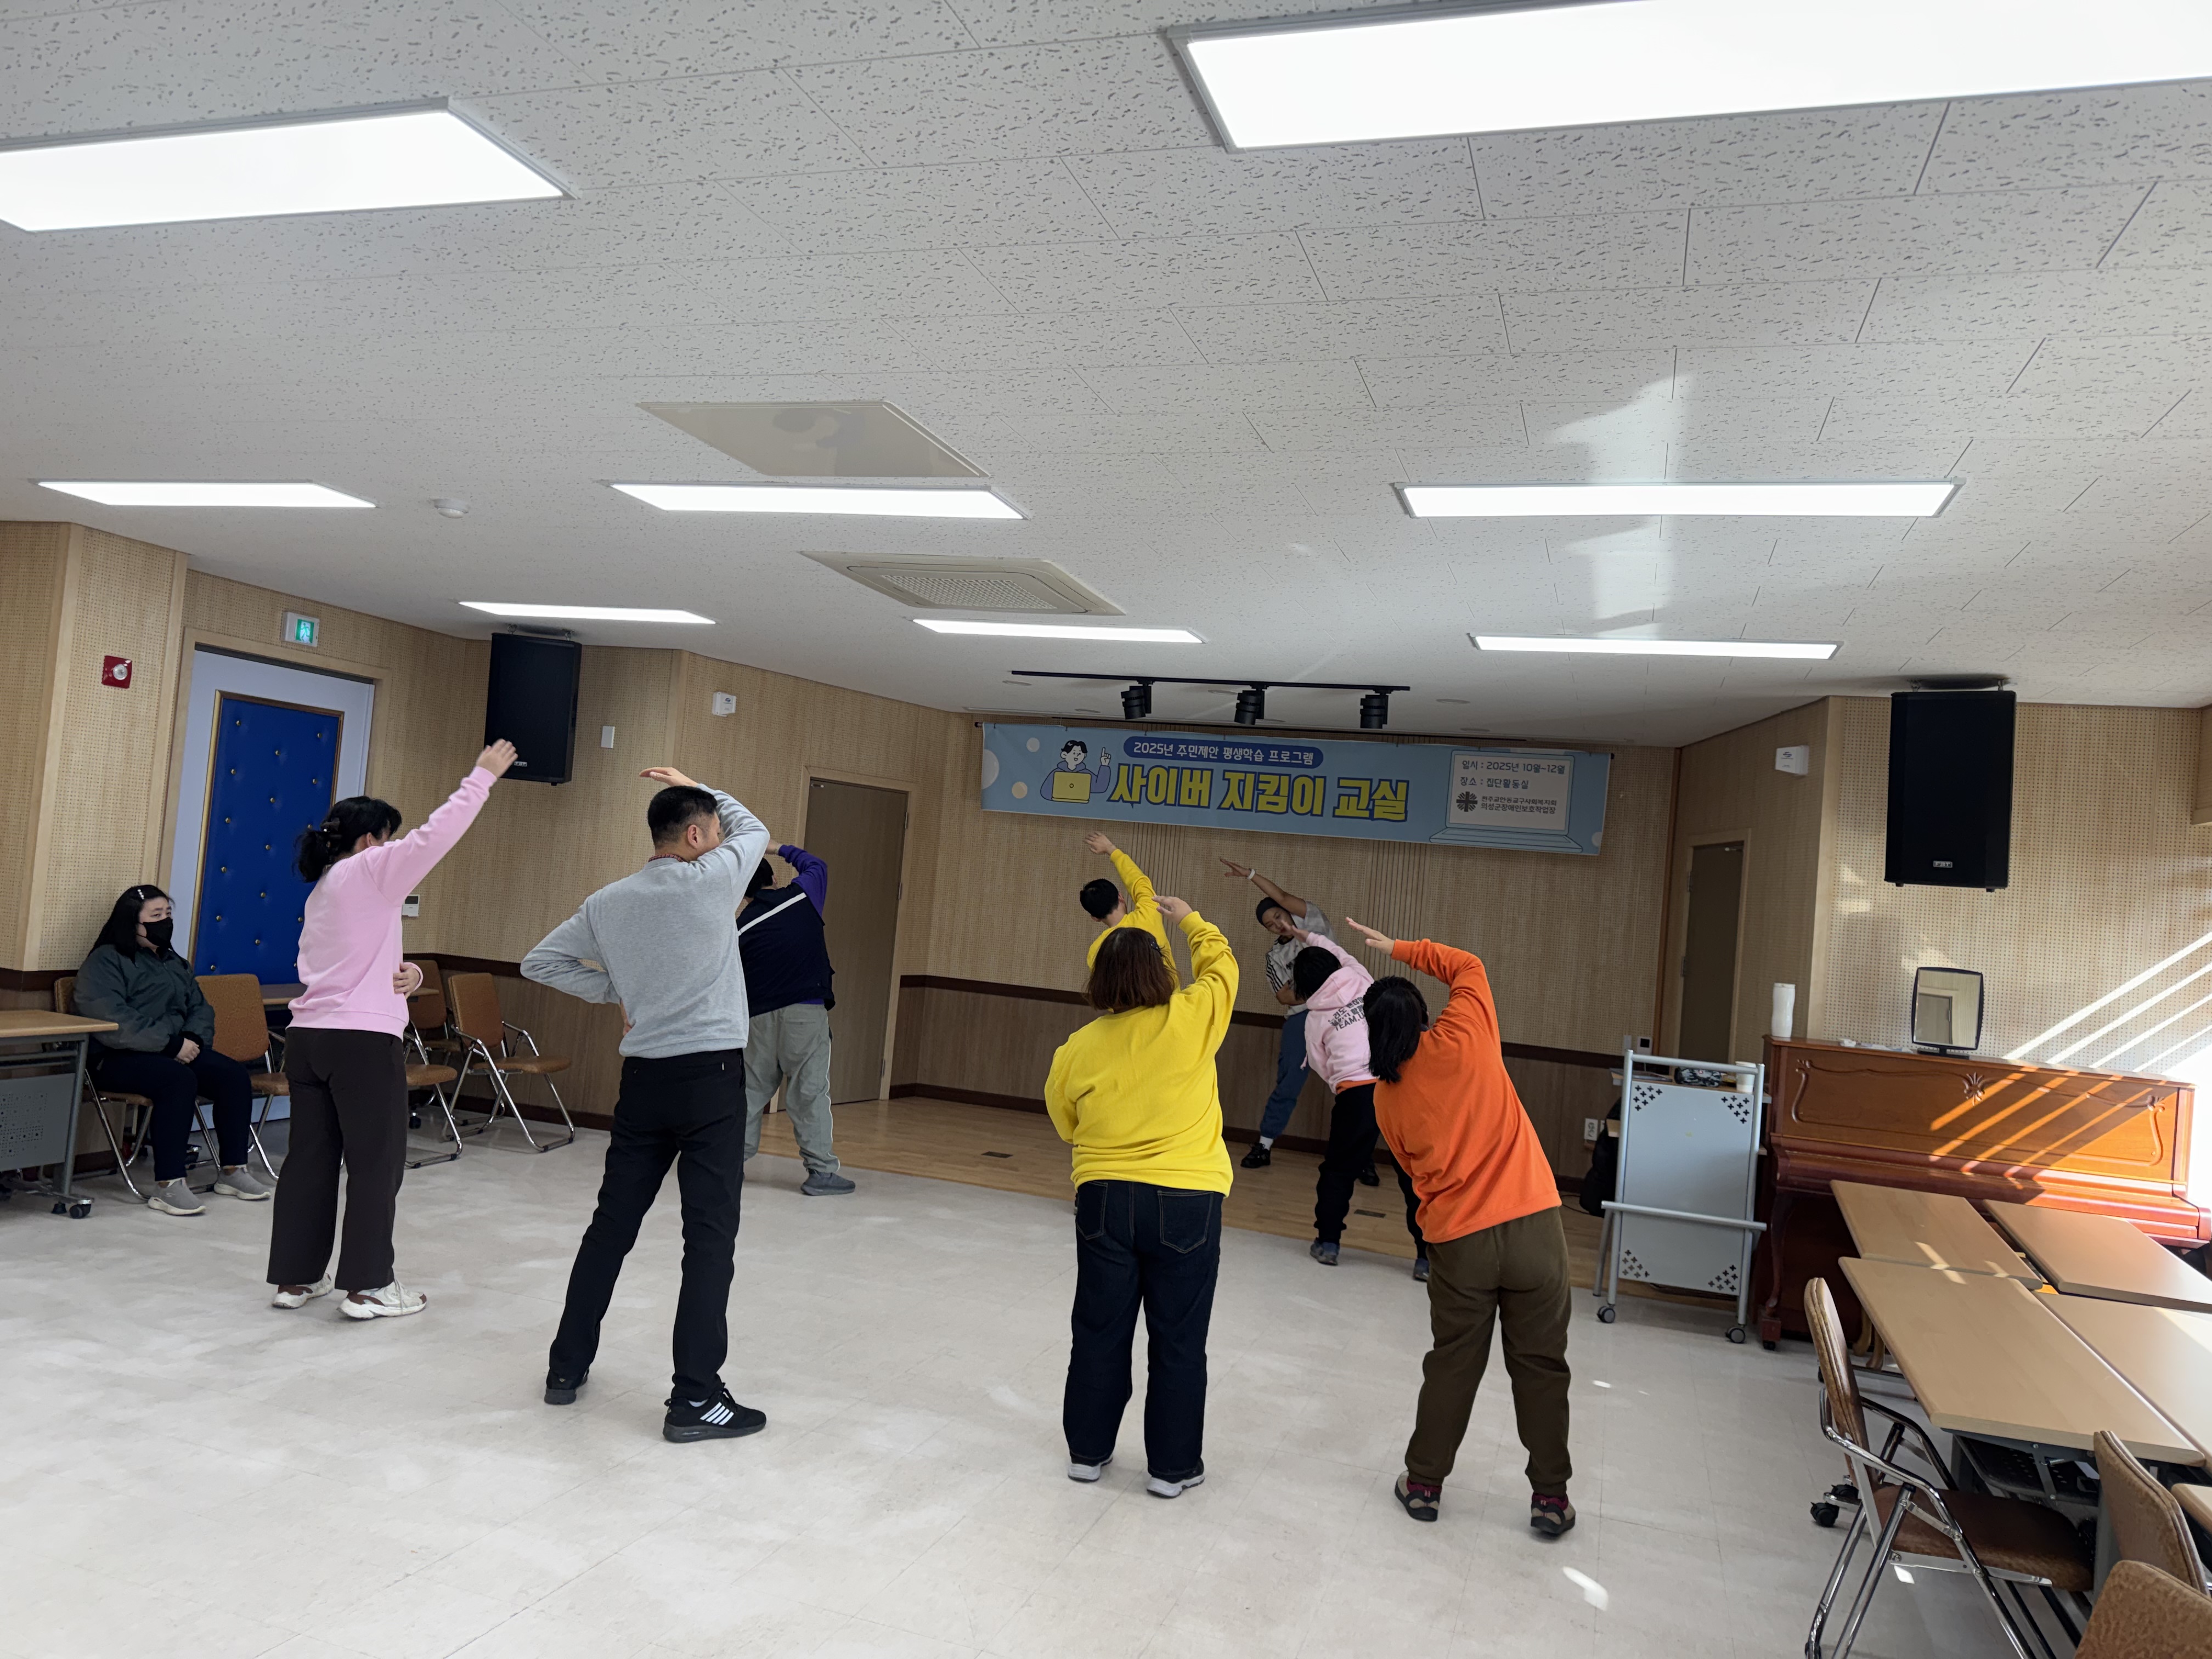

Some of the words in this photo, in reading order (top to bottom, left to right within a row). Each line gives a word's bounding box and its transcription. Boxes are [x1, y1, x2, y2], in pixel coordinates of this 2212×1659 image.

[1133, 742, 1174, 757] 2025년
[1177, 744, 1220, 760] 주민제안
[1223, 747, 1265, 763] 평생학습
[1268, 749, 1314, 765] 프로그램
[1462, 760, 1478, 770] 일시
[1486, 761, 1519, 772] 2025년
[1523, 763, 1565, 775] 10월~12월
[1107, 763, 1213, 808] 사이버
[1217, 770, 1327, 817] 지킴이
[1332, 777, 1409, 822] 교실
[1460, 777, 1477, 786] 장소
[1486, 778, 1529, 789] 집단활동실
